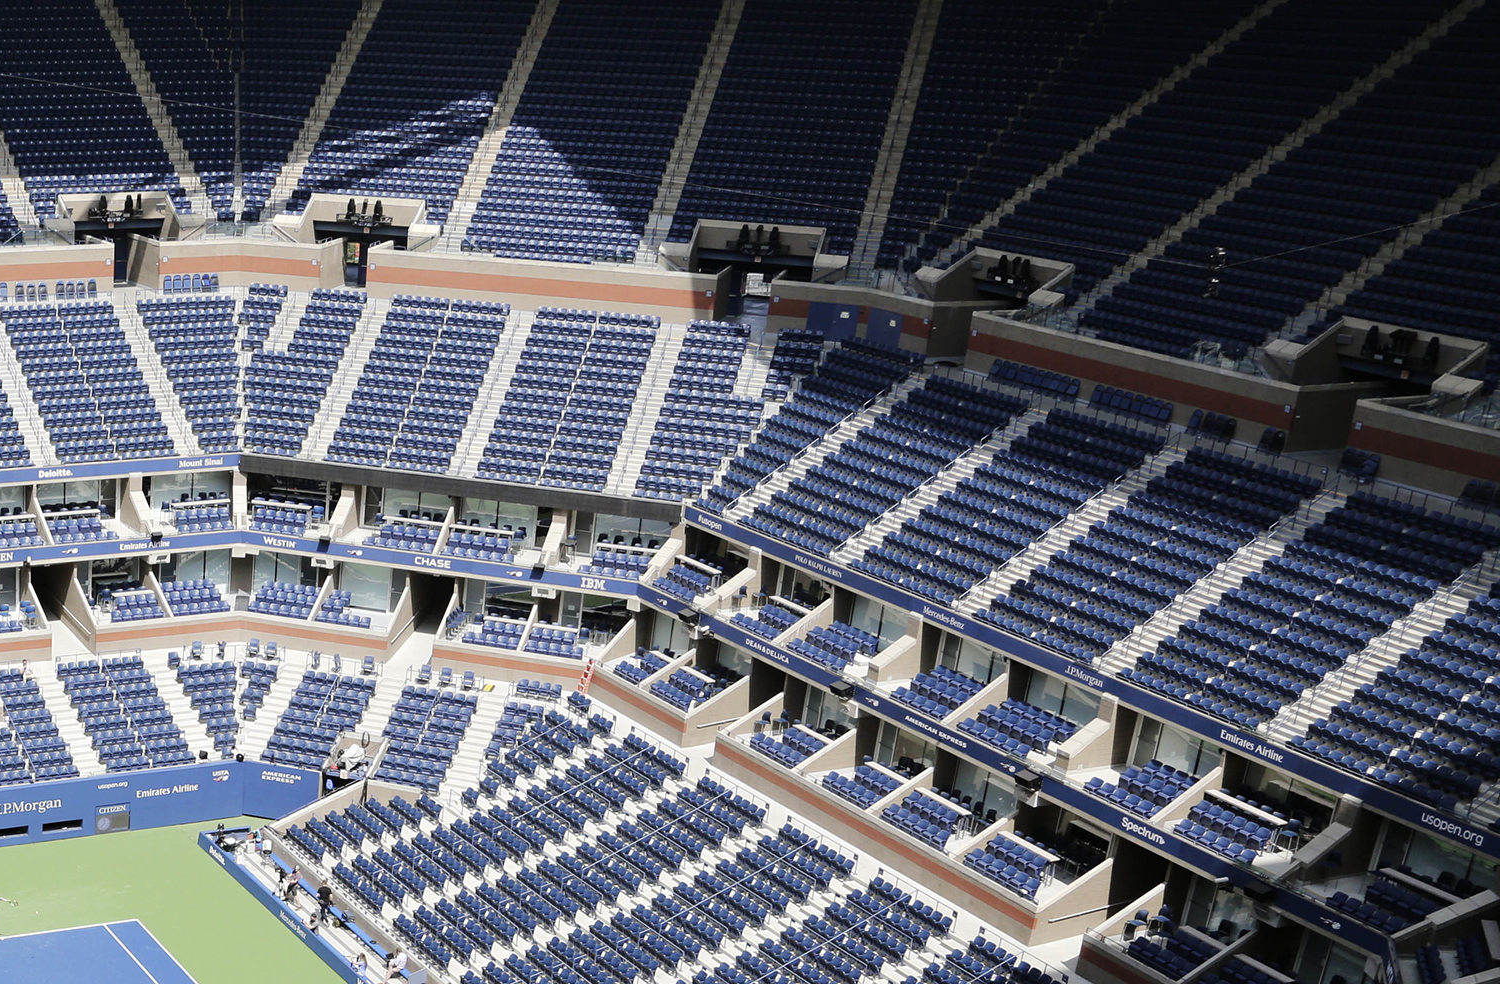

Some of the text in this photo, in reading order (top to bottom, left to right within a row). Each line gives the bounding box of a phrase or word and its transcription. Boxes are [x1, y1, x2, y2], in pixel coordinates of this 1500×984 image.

[179, 457, 223, 468] Mount Sinai
[119, 539, 170, 551] Emirates Airline
[263, 536, 297, 549] WESTIN
[414, 556, 451, 569] CHASE
[580, 577, 607, 591] IBM
[922, 605, 966, 631] Mercedes-Benz
[904, 714, 967, 748] AMERICAN EXPRESS
[1220, 729, 1284, 763] Emirates Airline
[262, 770, 302, 781] AMERICAN
[262, 775, 295, 784] EXPRESS
[98, 782, 129, 790] usopen.org
[136, 784, 198, 799] Emirates Airline
[98, 804, 127, 815] CITIZEN
[1121, 817, 1164, 845] Spectrum
[1421, 811, 1484, 847] usopen.org
